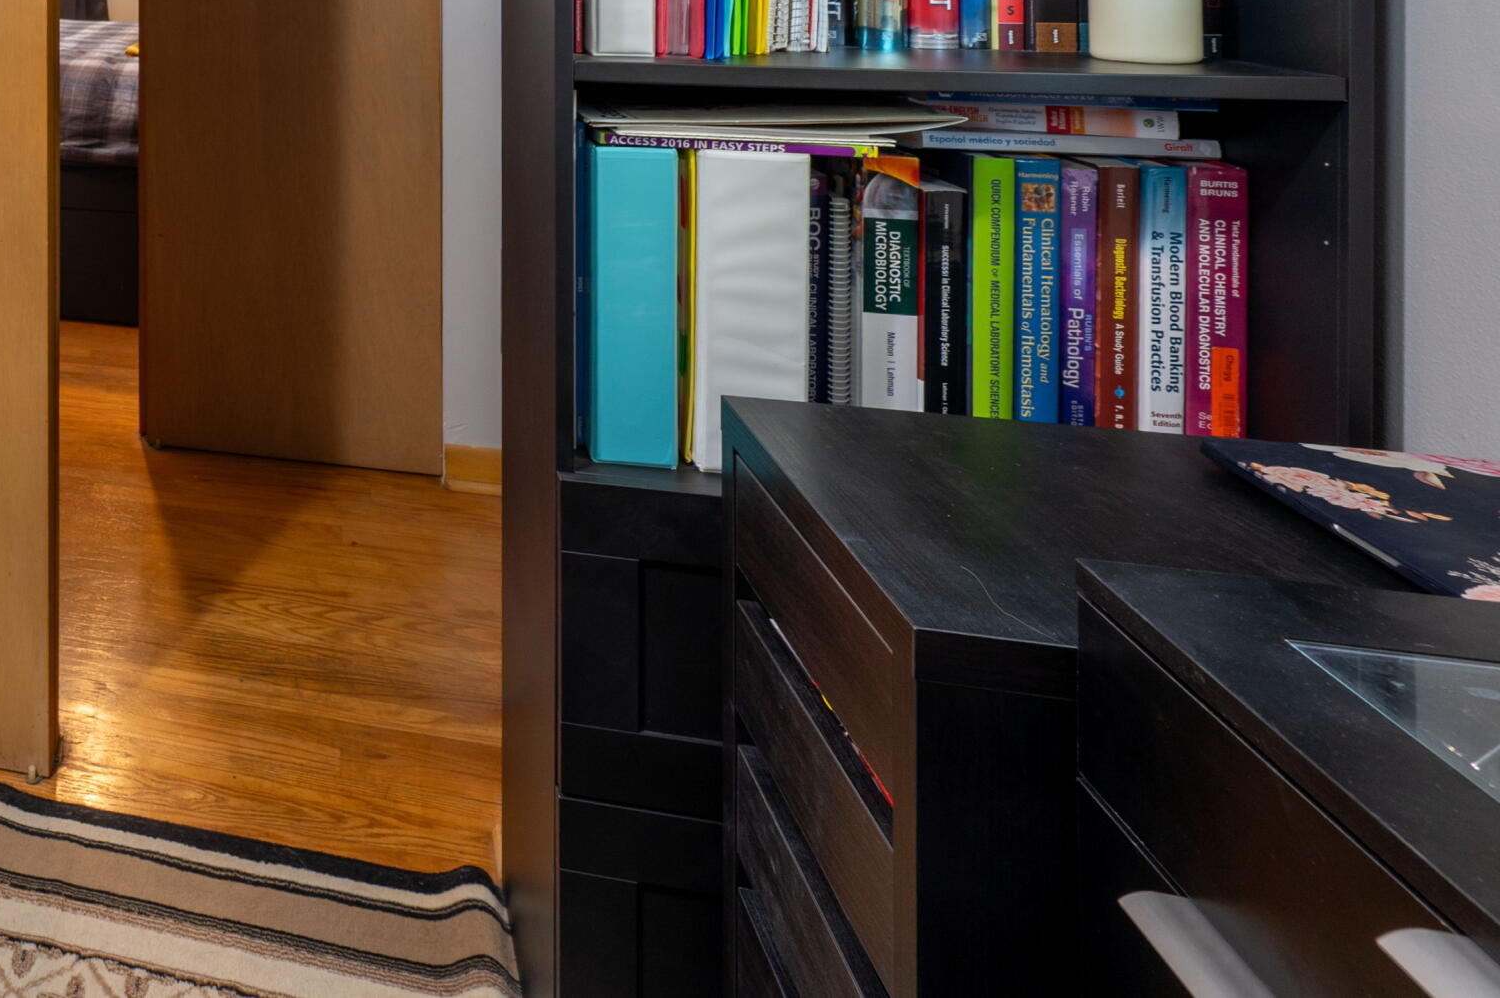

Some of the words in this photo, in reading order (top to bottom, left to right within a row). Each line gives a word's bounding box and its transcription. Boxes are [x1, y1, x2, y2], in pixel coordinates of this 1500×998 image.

[610, 135, 657, 147] ACCESS
[661, 137, 690, 149] 2016
[694, 139, 708, 150] IN
[712, 141, 744, 153] EASY
[747, 142, 786, 153] STEPS
[928, 133, 966, 145] Español
[968, 135, 1003, 146] médico
[1005, 138, 1011, 146] y
[1013, 137, 1056, 147] sociedad
[1164, 142, 1194, 152] Giralt
[991, 179, 1002, 205] QUICK
[1081, 186, 1091, 212] Rubin
[1200, 179, 1239, 189] BURTIS
[1200, 188, 1239, 198] BRUNS
[990, 206, 1002, 266] COMPENDIUM
[1040, 218, 1055, 271] Clinical
[1151, 231, 1164, 241] &
[1198, 218, 1210, 241] AND
[1215, 219, 1226, 269] CLINICAL
[874, 221, 887, 312] MICROBIOLOGY
[888, 231, 900, 302] DIAGNOSTIC
[1021, 218, 1036, 319] Fundamentals
[1074, 233, 1084, 287] Essentials
[1114, 238, 1127, 274] Diagnostic
[1169, 231, 1184, 286] Modern
[1232, 238, 1241, 286] Fundamentals
[903, 278, 910, 288] OF
[942, 284, 950, 308] Clinical
[1074, 288, 1083, 301] of
[1151, 244, 1165, 326] Transfusion
[1198, 245, 1211, 312] MOLECULAR
[1232, 288, 1240, 298] of
[990, 279, 1001, 320] MEDICAL
[1112, 275, 1127, 320] Bacteriology
[1170, 290, 1183, 332] Blood
[1214, 271, 1227, 338] CHEMISTRY
[940, 308, 950, 342] Laboratory
[1020, 320, 1031, 331] of
[1037, 274, 1054, 361] Hematology
[1084, 313, 1093, 352] RUBIN'S
[1115, 323, 1125, 331] A
[887, 331, 895, 357] Mahon
[941, 343, 949, 367] Science
[990, 321, 1000, 378] LABORATORY
[1062, 306, 1085, 389] Pathology
[1114, 332, 1125, 351] Study
[1198, 315, 1211, 391] DIAGNOSTICS
[1020, 335, 1036, 419] Hemostasis
[1040, 364, 1049, 384] and
[1114, 353, 1125, 375] Guide
[1151, 329, 1164, 392] Practices
[1165, 334, 1183, 394] Banking
[887, 368, 895, 397] Lehman
[1151, 411, 1182, 421] Seventh
[1152, 419, 1181, 429] Edition
